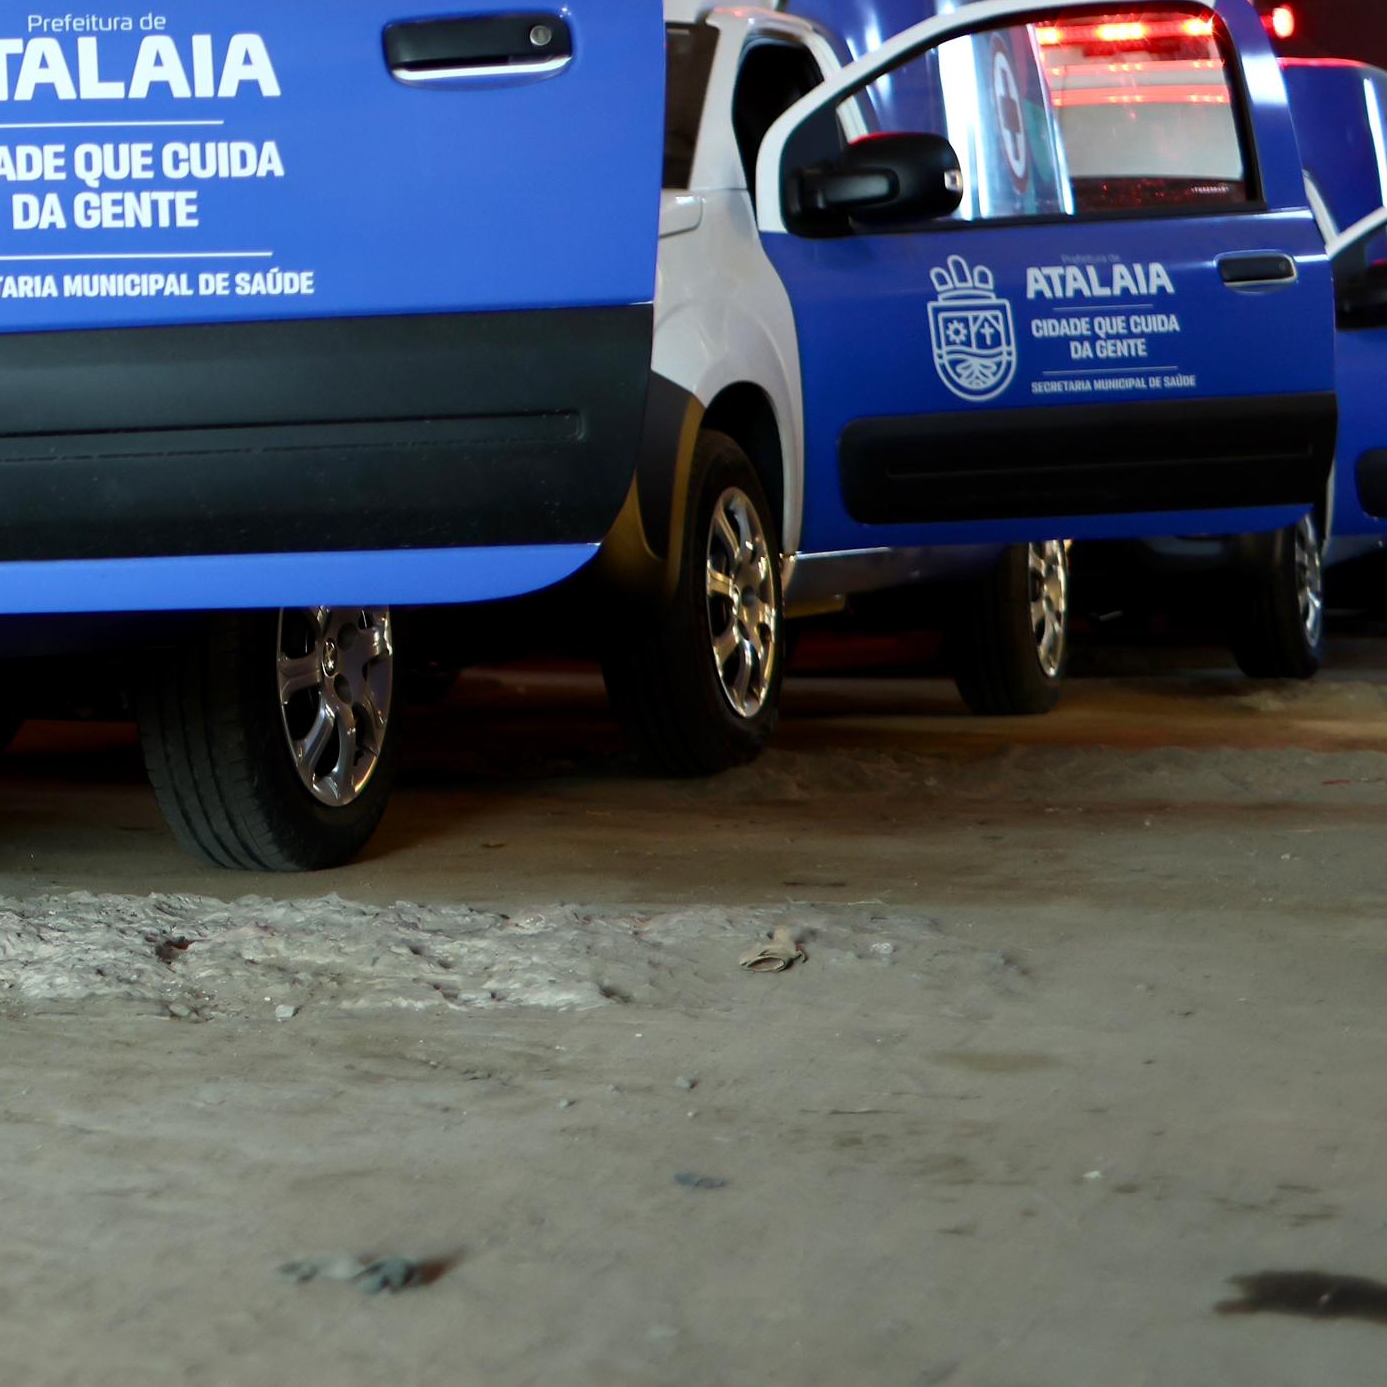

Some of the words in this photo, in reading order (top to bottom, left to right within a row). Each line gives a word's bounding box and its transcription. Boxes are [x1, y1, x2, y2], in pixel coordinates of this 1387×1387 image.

[28, 14, 132, 32] Prefeitura
[140, 13, 166, 30] de
[74, 143, 154, 188] QUE
[162, 141, 284, 178] CUIDA
[12, 193, 66, 229] DA
[74, 190, 198, 228] GENTE
[63, 274, 193, 297] MUNICIPAL
[199, 273, 229, 295] DE
[235, 268, 314, 295] SAÚDE
[1026, 263, 1175, 299] ATALAIA
[1032, 318, 1091, 337] CIDADE
[1094, 317, 1128, 340] QUE
[1130, 314, 1180, 333] CUIDA
[1070, 341, 1093, 358] DA
[1096, 339, 1147, 357] GENTE
[1032, 380, 1093, 393] SECRETARIA
[1094, 378, 1147, 390] MUNICIPAL
[1149, 377, 1162, 387] DE
[1164, 374, 1196, 387] SAÚDE
